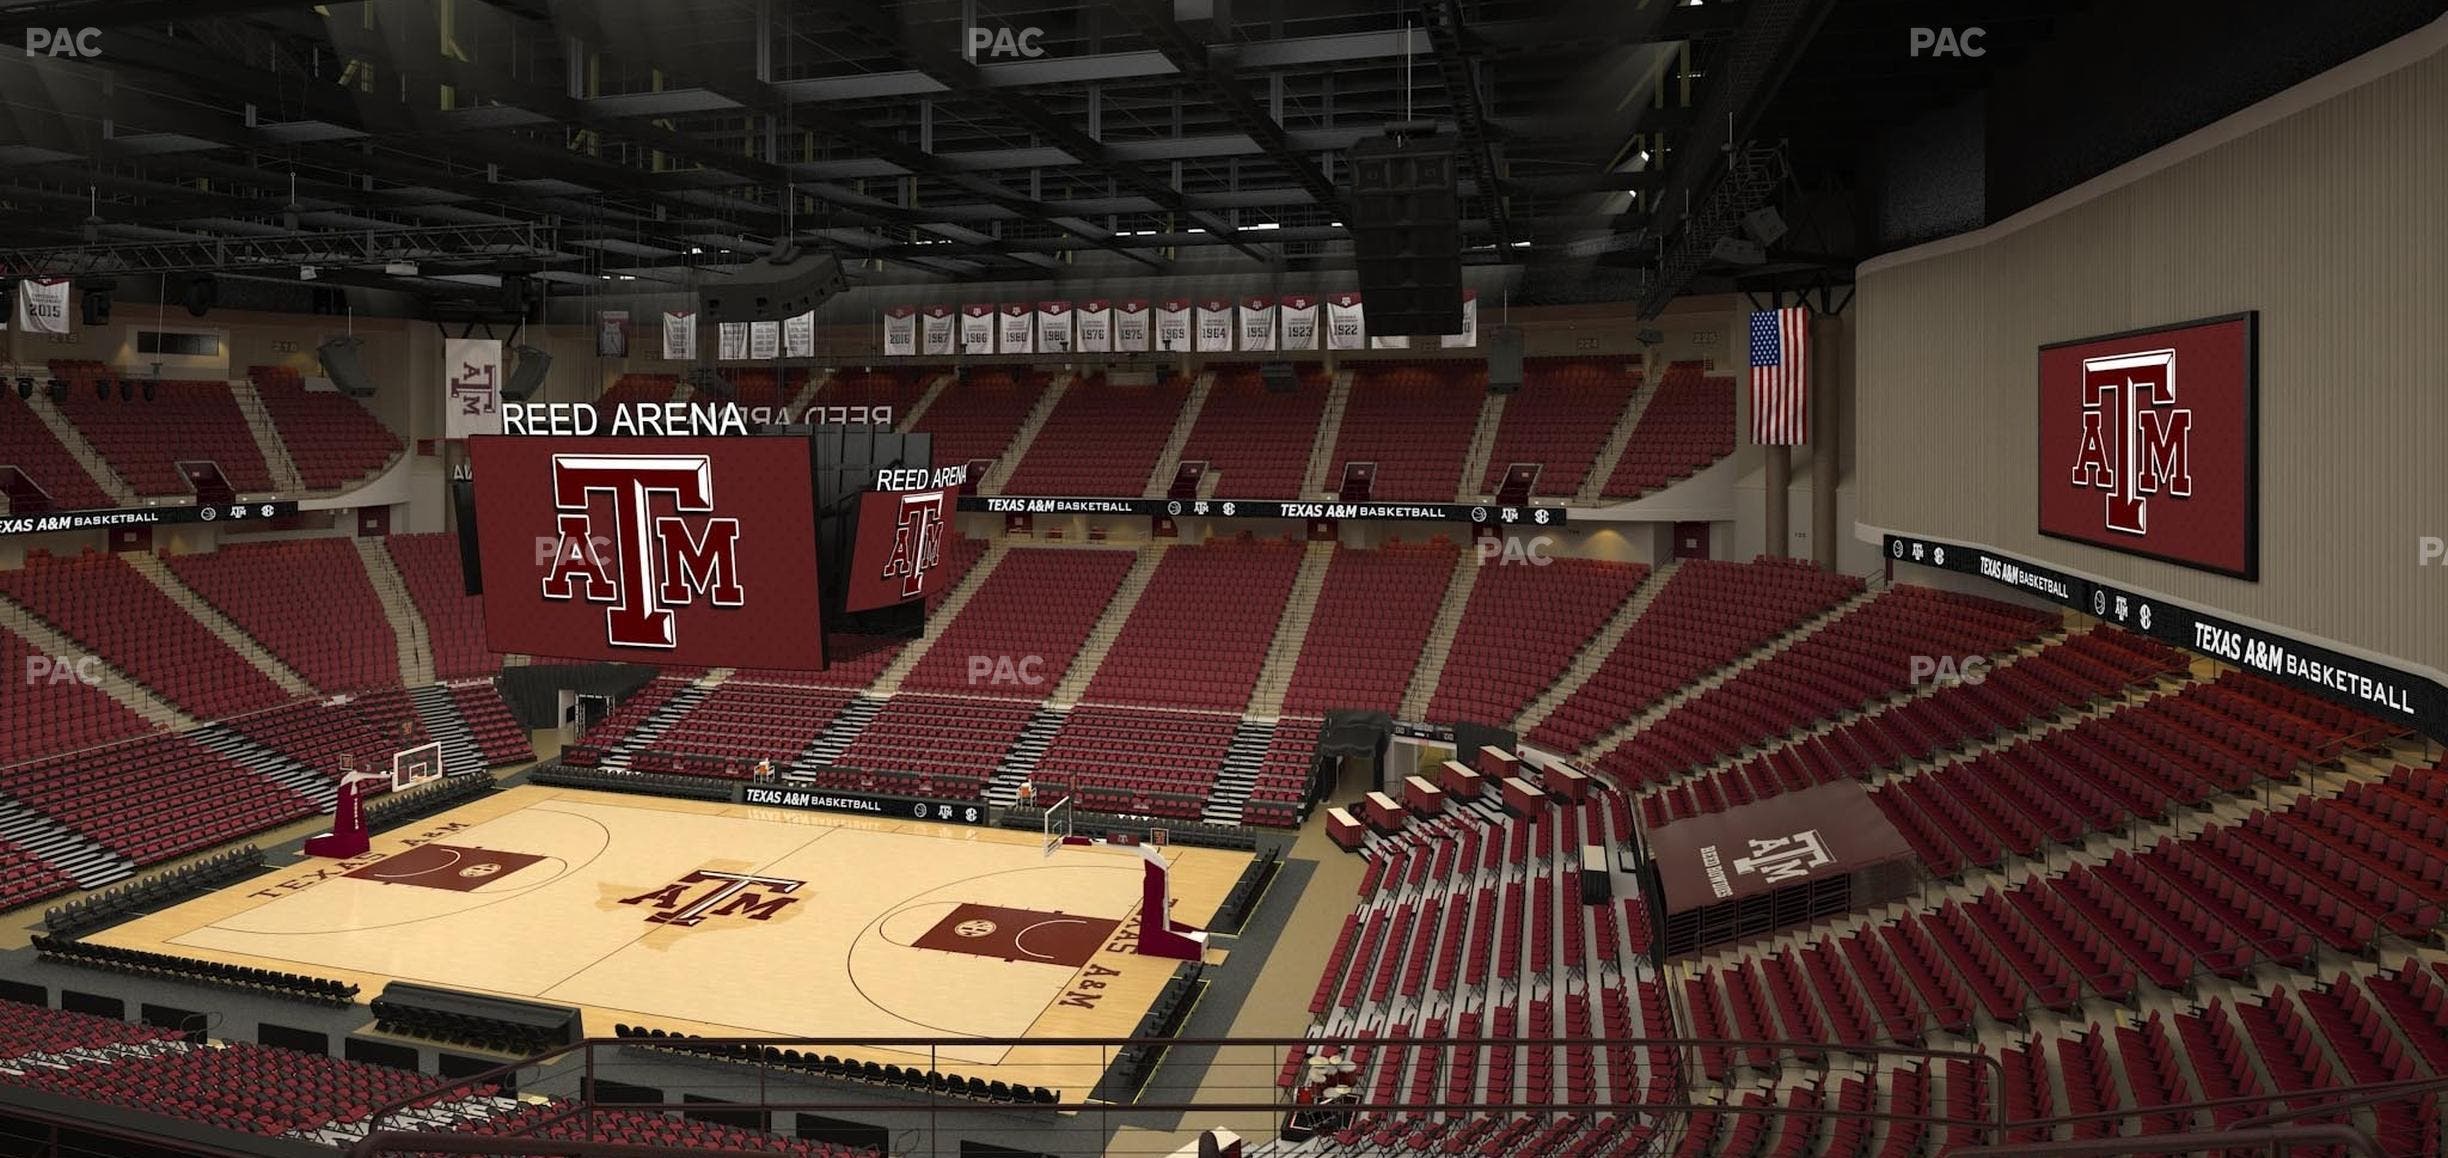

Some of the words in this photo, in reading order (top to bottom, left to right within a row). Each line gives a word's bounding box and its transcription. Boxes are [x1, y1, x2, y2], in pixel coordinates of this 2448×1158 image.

[30, 304, 61, 318] 2015
[1161, 329, 1185, 340] 1969
[1334, 325, 1358, 336] 1922
[502, 402, 598, 436] REED
[611, 402, 749, 436] ARENA
[876, 469, 929, 491] REED
[931, 464, 967, 489] ARENA
[987, 499, 1026, 512] TEXAS
[1027, 499, 1055, 513] A&M
[1057, 502, 1132, 512] BASKETBALL
[1280, 504, 1323, 517] TEXAS
[1325, 504, 1358, 518] A&M
[1360, 506, 1446, 518] BASKETBALL
[36, 515, 73, 531] A&M
[74, 512, 159, 526] BASKETBALL
[1980, 556, 2001, 579] TEXAS
[2001, 563, 2019, 585] A&M
[2019, 570, 2069, 599] BASKETBALL
[2195, 622, 2242, 661] TEXAS
[2244, 638, 2283, 675] A&M
[2287, 653, 2415, 714] BASKETBALL
[746, 788, 782, 804] TEXAS
[783, 791, 811, 807] A&M
[811, 796, 881, 811] BASKETBALL
[401, 821, 471, 848] A&M
[1058, 964, 1121, 1009] A&M
